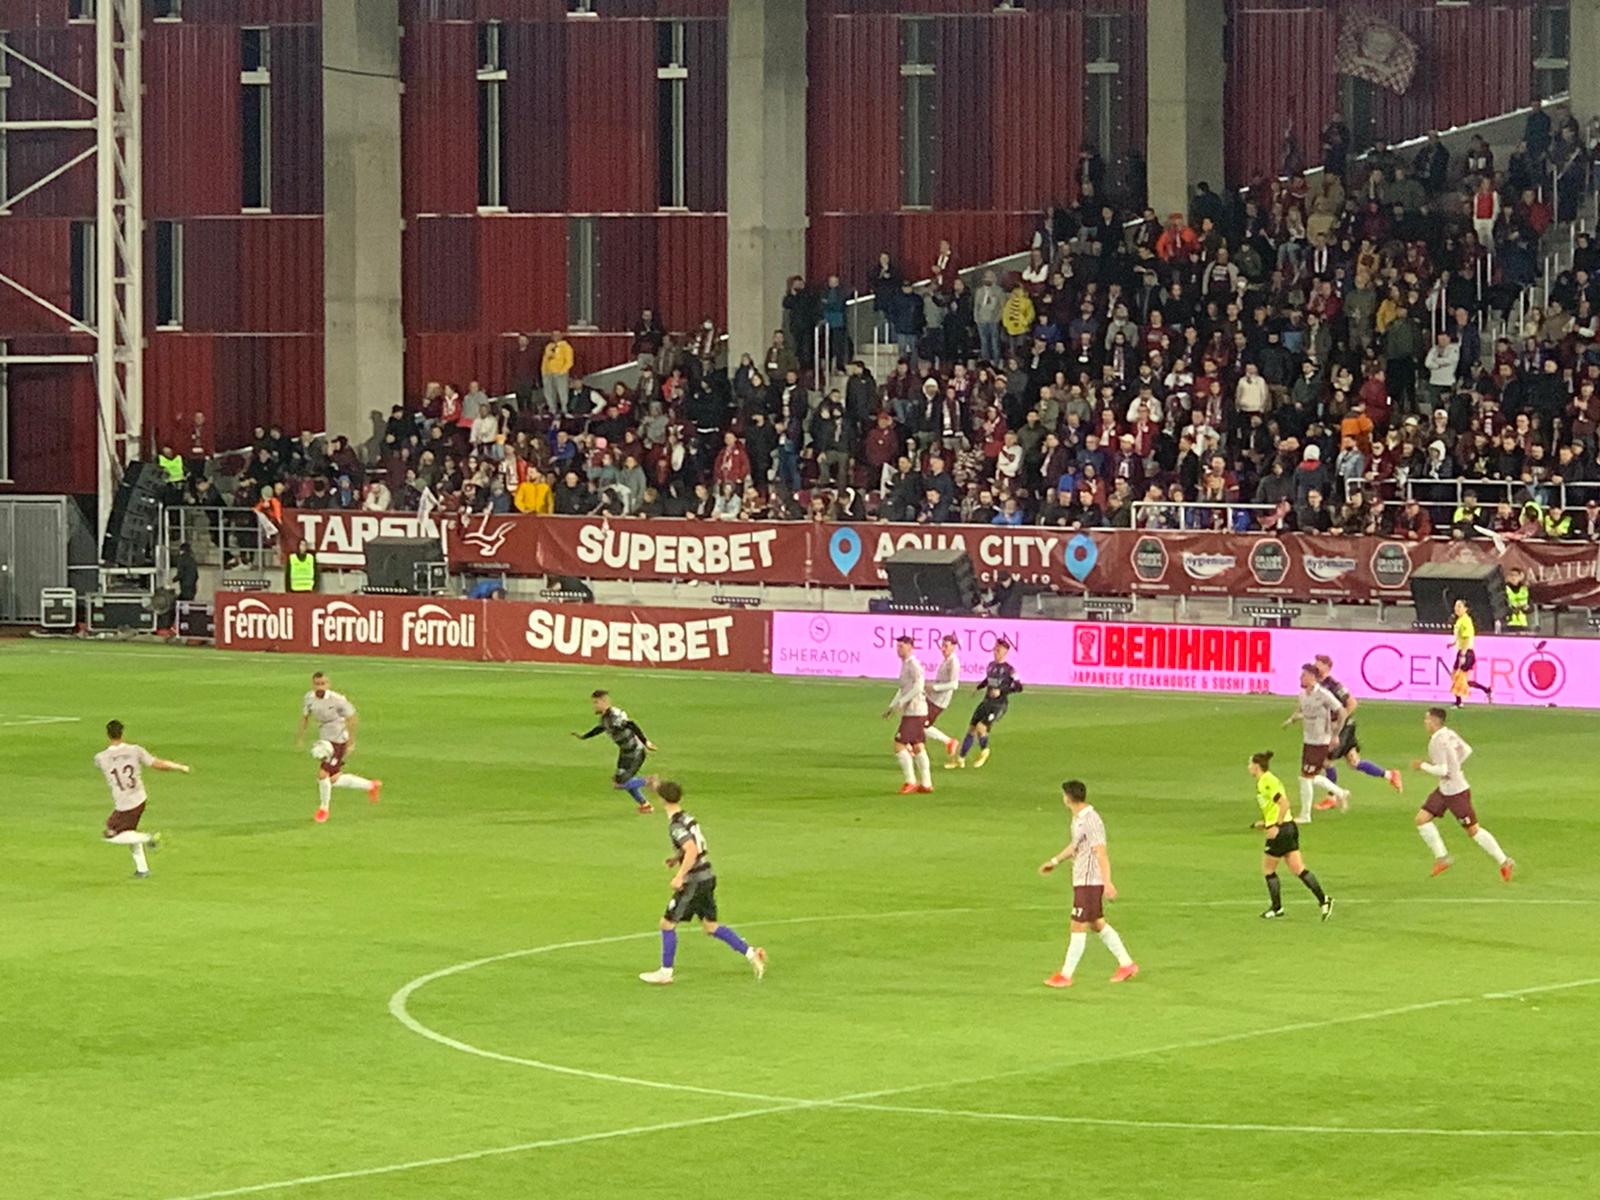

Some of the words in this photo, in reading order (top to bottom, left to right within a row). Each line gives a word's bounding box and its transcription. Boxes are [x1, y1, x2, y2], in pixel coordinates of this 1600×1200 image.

[577, 525, 777, 574] SUPERBET
[979, 535, 1058, 567] CITY
[525, 609, 733, 662] SUPERBET
[873, 625, 1020, 653] SHERATON
[1103, 625, 1271, 673] BENIHANA
[1072, 671, 1124, 686] JAPANESE
[1129, 673, 1196, 689] STEAKHOUSE
[1212, 677, 1244, 690] SUSHI
[110, 764, 137, 791] 13
